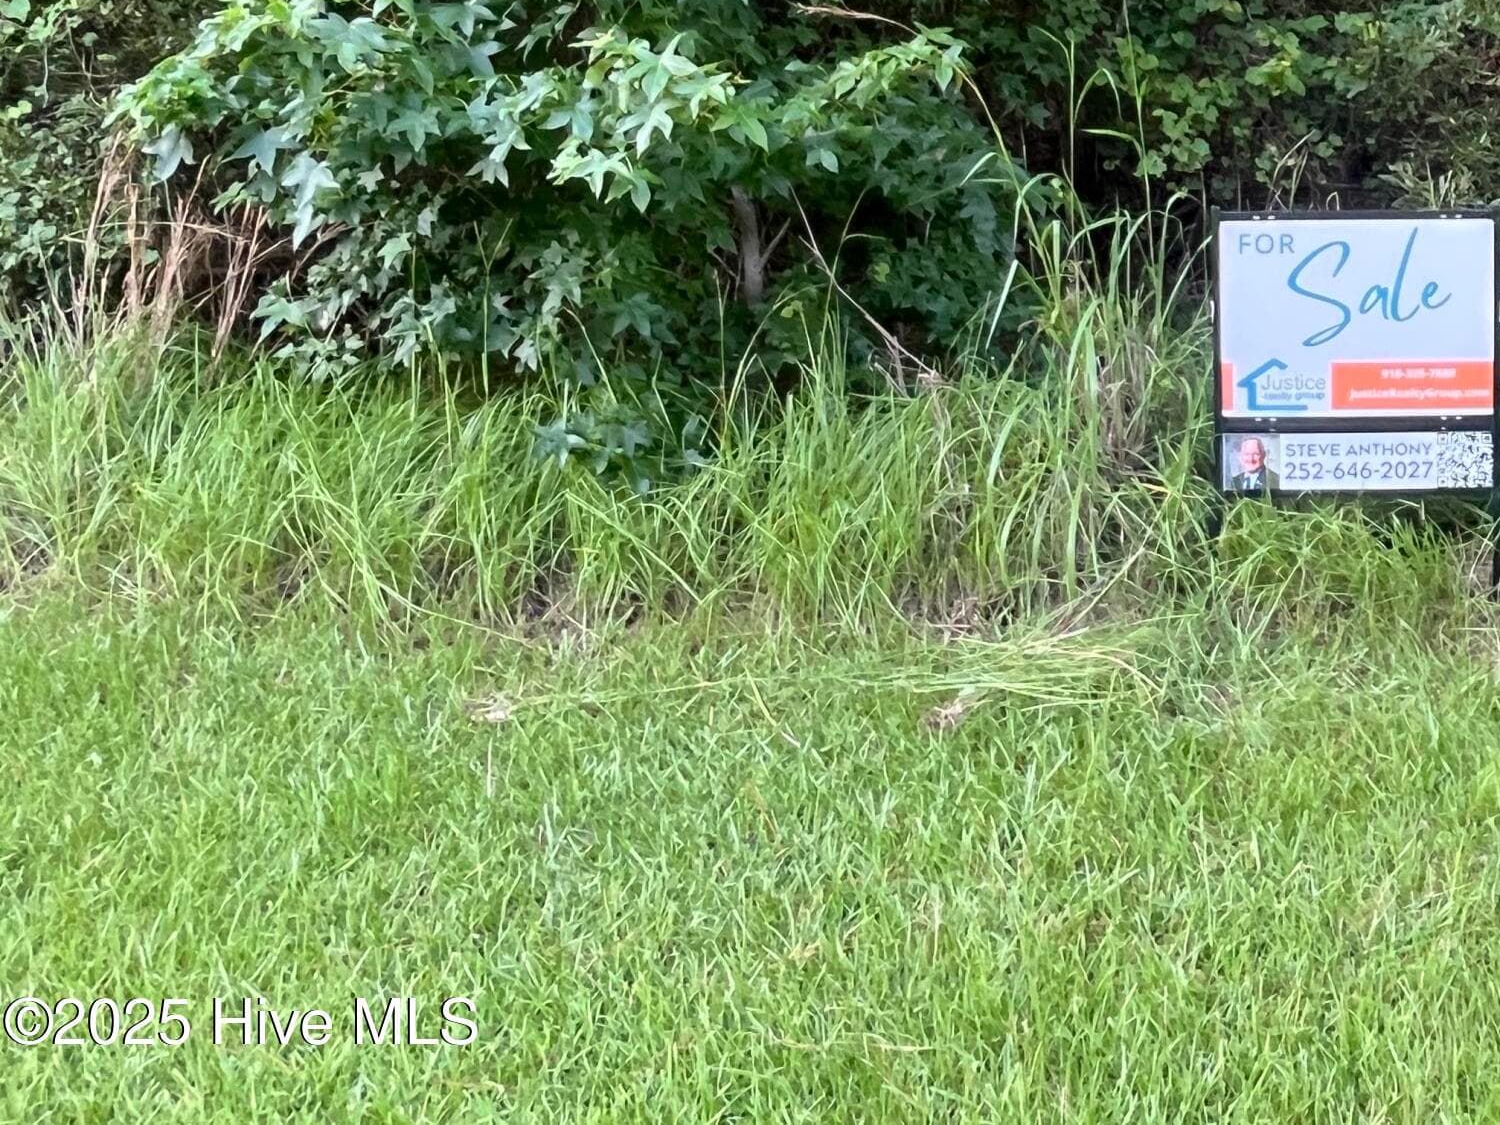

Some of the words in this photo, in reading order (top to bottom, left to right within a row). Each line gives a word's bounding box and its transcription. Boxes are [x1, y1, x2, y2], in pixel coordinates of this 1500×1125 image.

[1238, 233, 1296, 255] FOR
[1286, 226, 1452, 347] Sale
[1261, 374, 1327, 391] Justice
[1284, 443, 1341, 457] STEVE
[1345, 442, 1434, 456] ANTHONY
[1284, 460, 1434, 481] 252-646-2027
